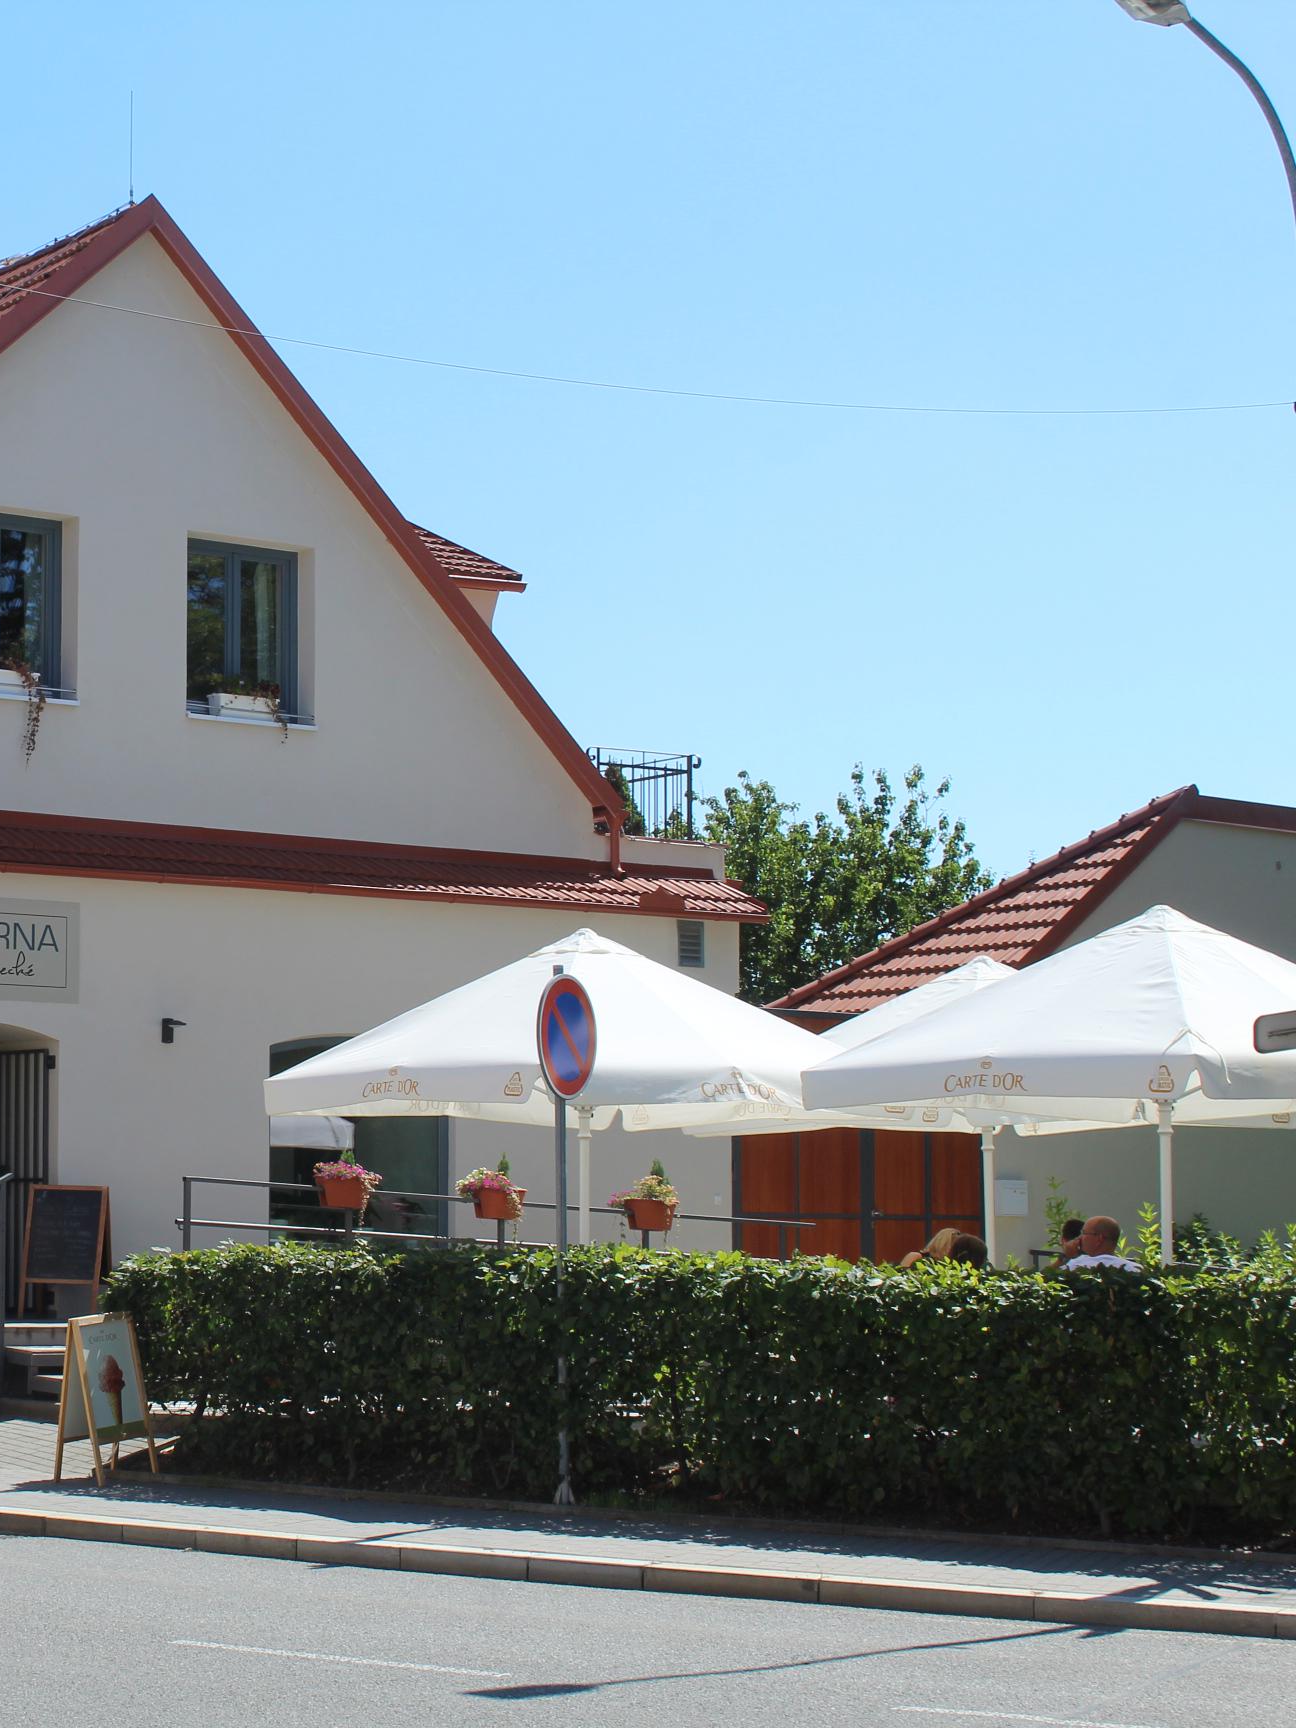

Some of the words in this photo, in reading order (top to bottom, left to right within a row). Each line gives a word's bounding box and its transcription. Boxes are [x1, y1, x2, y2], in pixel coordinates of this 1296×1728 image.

[362, 1080, 394, 1097] CARTE
[398, 1079, 420, 1096] D'OR
[700, 1082, 745, 1098] CARTE
[944, 1074, 989, 1092] CARTE
[992, 1072, 1029, 1092] D'OR
